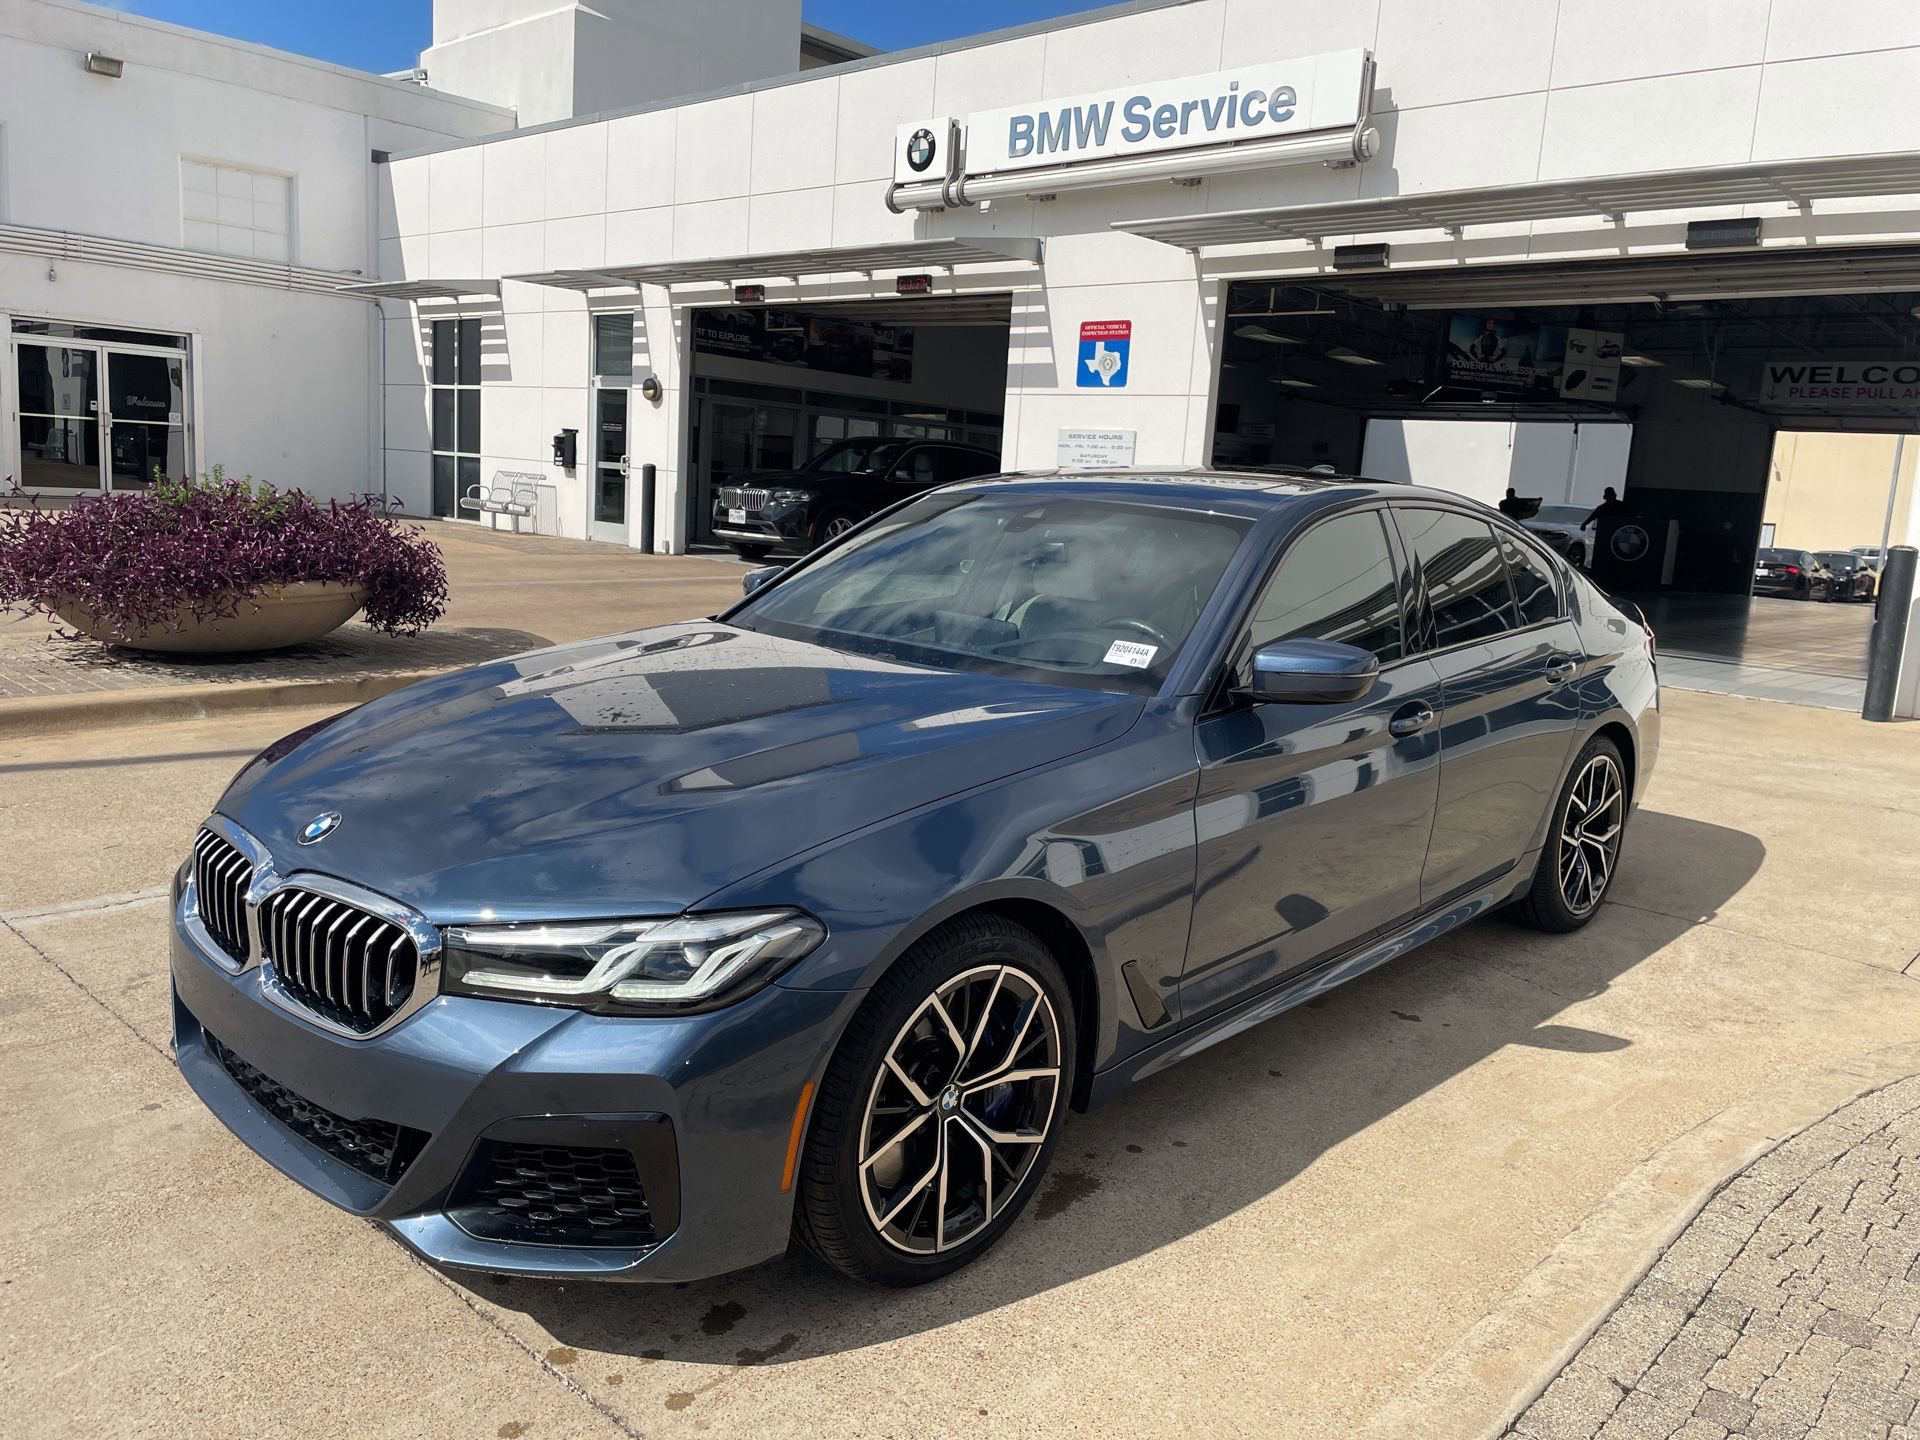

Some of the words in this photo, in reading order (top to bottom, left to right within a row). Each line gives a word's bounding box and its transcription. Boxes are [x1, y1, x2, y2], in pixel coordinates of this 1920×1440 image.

[1008, 100, 1115, 158] BMW
[1121, 80, 1297, 144] Service
[707, 330, 718, 338] TO
[1452, 359, 1495, 372] POWERFUL
[1789, 387, 1850, 398] PLEASE
[1856, 388, 1897, 399] PULL
